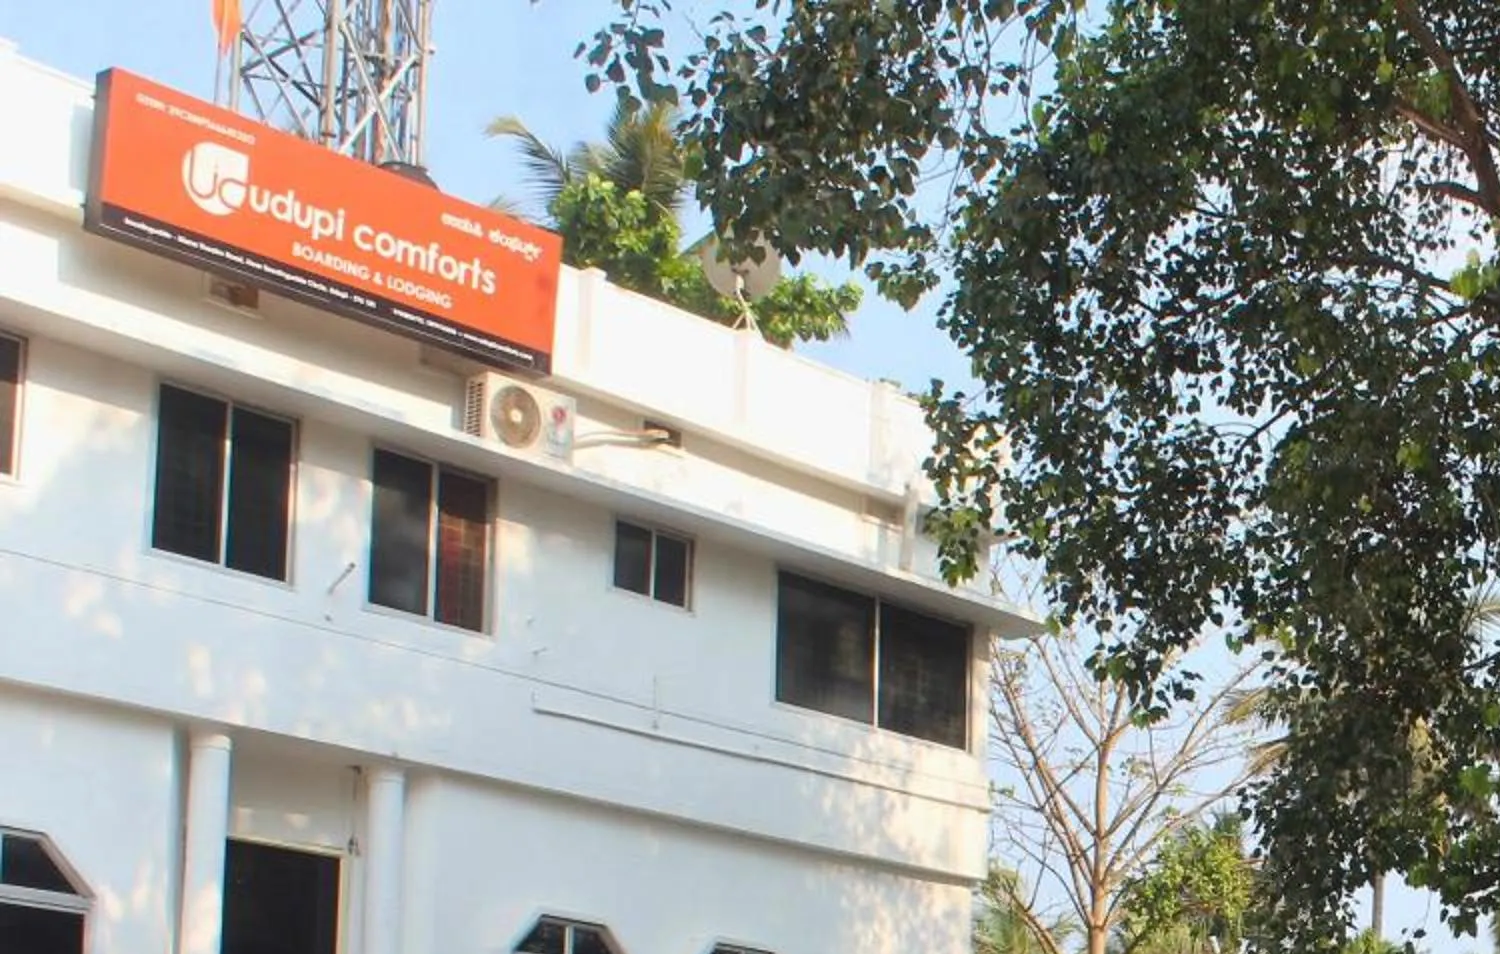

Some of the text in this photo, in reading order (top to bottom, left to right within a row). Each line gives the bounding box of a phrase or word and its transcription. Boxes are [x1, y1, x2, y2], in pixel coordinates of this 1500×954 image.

[249, 184, 346, 241] udupi
[352, 224, 497, 295] comforts
[291, 241, 371, 281] BOARDING
[372, 271, 384, 286] &
[386, 274, 453, 310] LODGING
